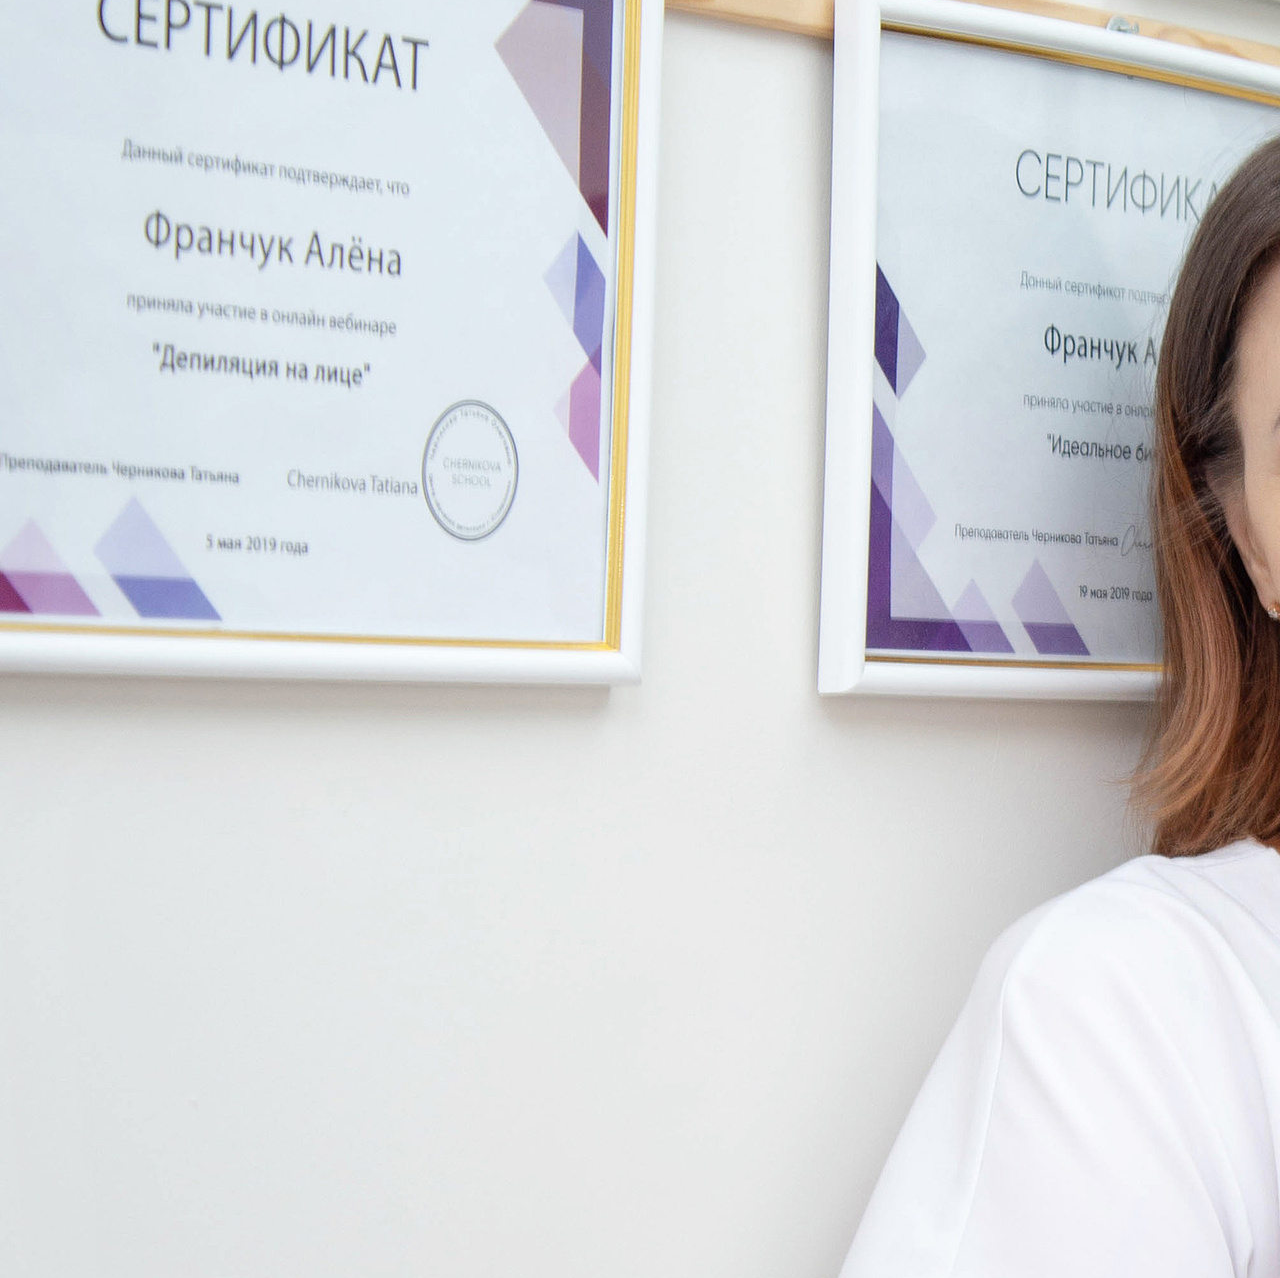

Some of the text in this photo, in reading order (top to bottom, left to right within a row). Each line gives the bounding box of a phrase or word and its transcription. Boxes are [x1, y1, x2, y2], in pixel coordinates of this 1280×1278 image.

[121, 137, 410, 197] Данный сертификат подтверждает, что
[144, 208, 402, 277] Франчук Алёна
[1020, 270, 1062, 291] Данный
[1064, 277, 1126, 300] сертификат
[126, 291, 397, 337] приняла участие в онлайн вебинаре
[1044, 323, 1137, 370] Франчук
[152, 341, 371, 389] "Депиляция на лице"
[1023, 393, 1069, 411] приняла
[1071, 399, 1113, 415] участие
[1116, 404, 1122, 414] в
[1047, 432, 1132, 460] "Идеальное
[0, 452, 240, 485] Преподаватель Черникова Татьяна
[442, 455, 501, 474] CHERNIKOVA
[287, 468, 418, 497] Chernikova Tatiana
[450, 472, 492, 488] SCHOOL
[205, 533, 308, 557] 5 мая 2019 года
[954, 523, 1030, 542] Преподаватель
[1032, 528, 1082, 544] Черникова
[1084, 531, 1118, 548] Татьяна
[1079, 584, 1153, 604] 19 мая 2019 года
